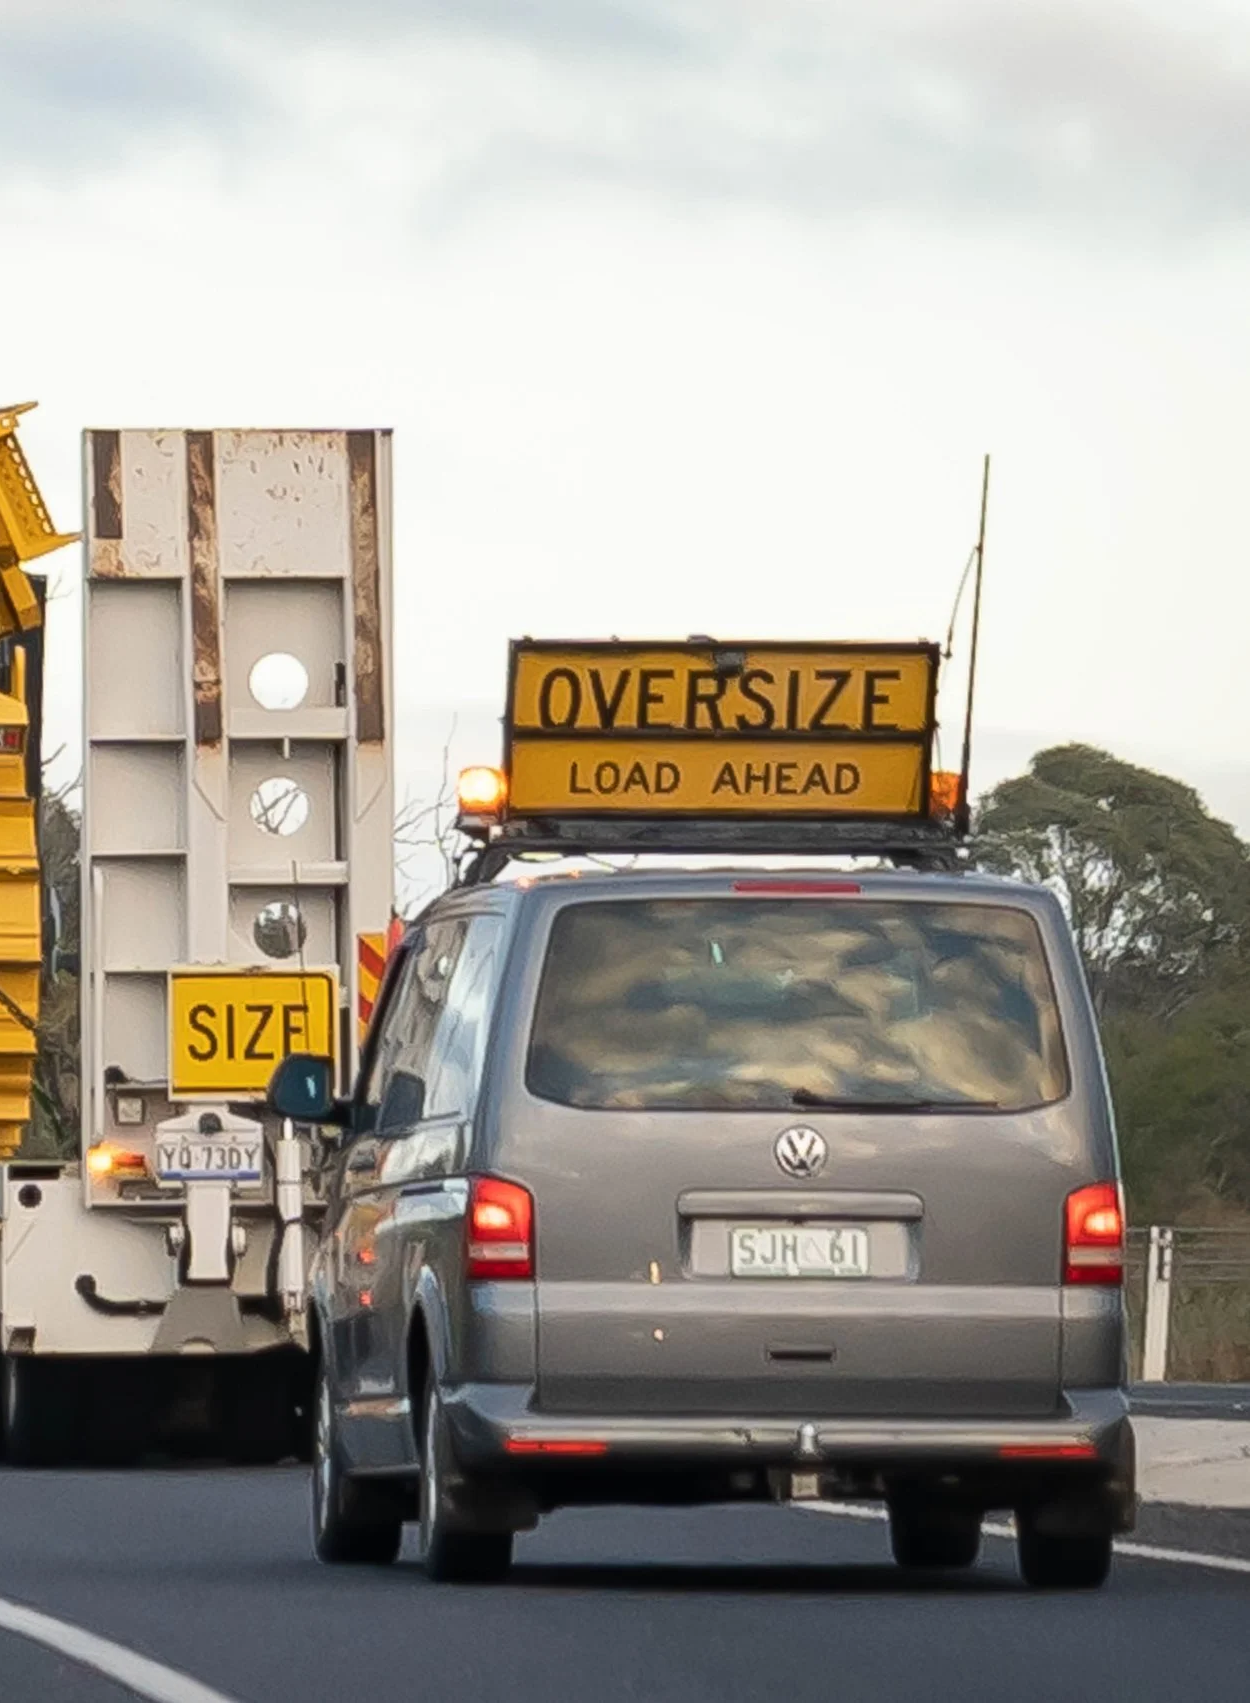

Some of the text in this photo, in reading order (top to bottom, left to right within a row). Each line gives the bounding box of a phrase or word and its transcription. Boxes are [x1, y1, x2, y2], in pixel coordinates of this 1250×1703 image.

[538, 667, 902, 731] OVERSIZE
[570, 761, 861, 795] LOAD AHEAD
